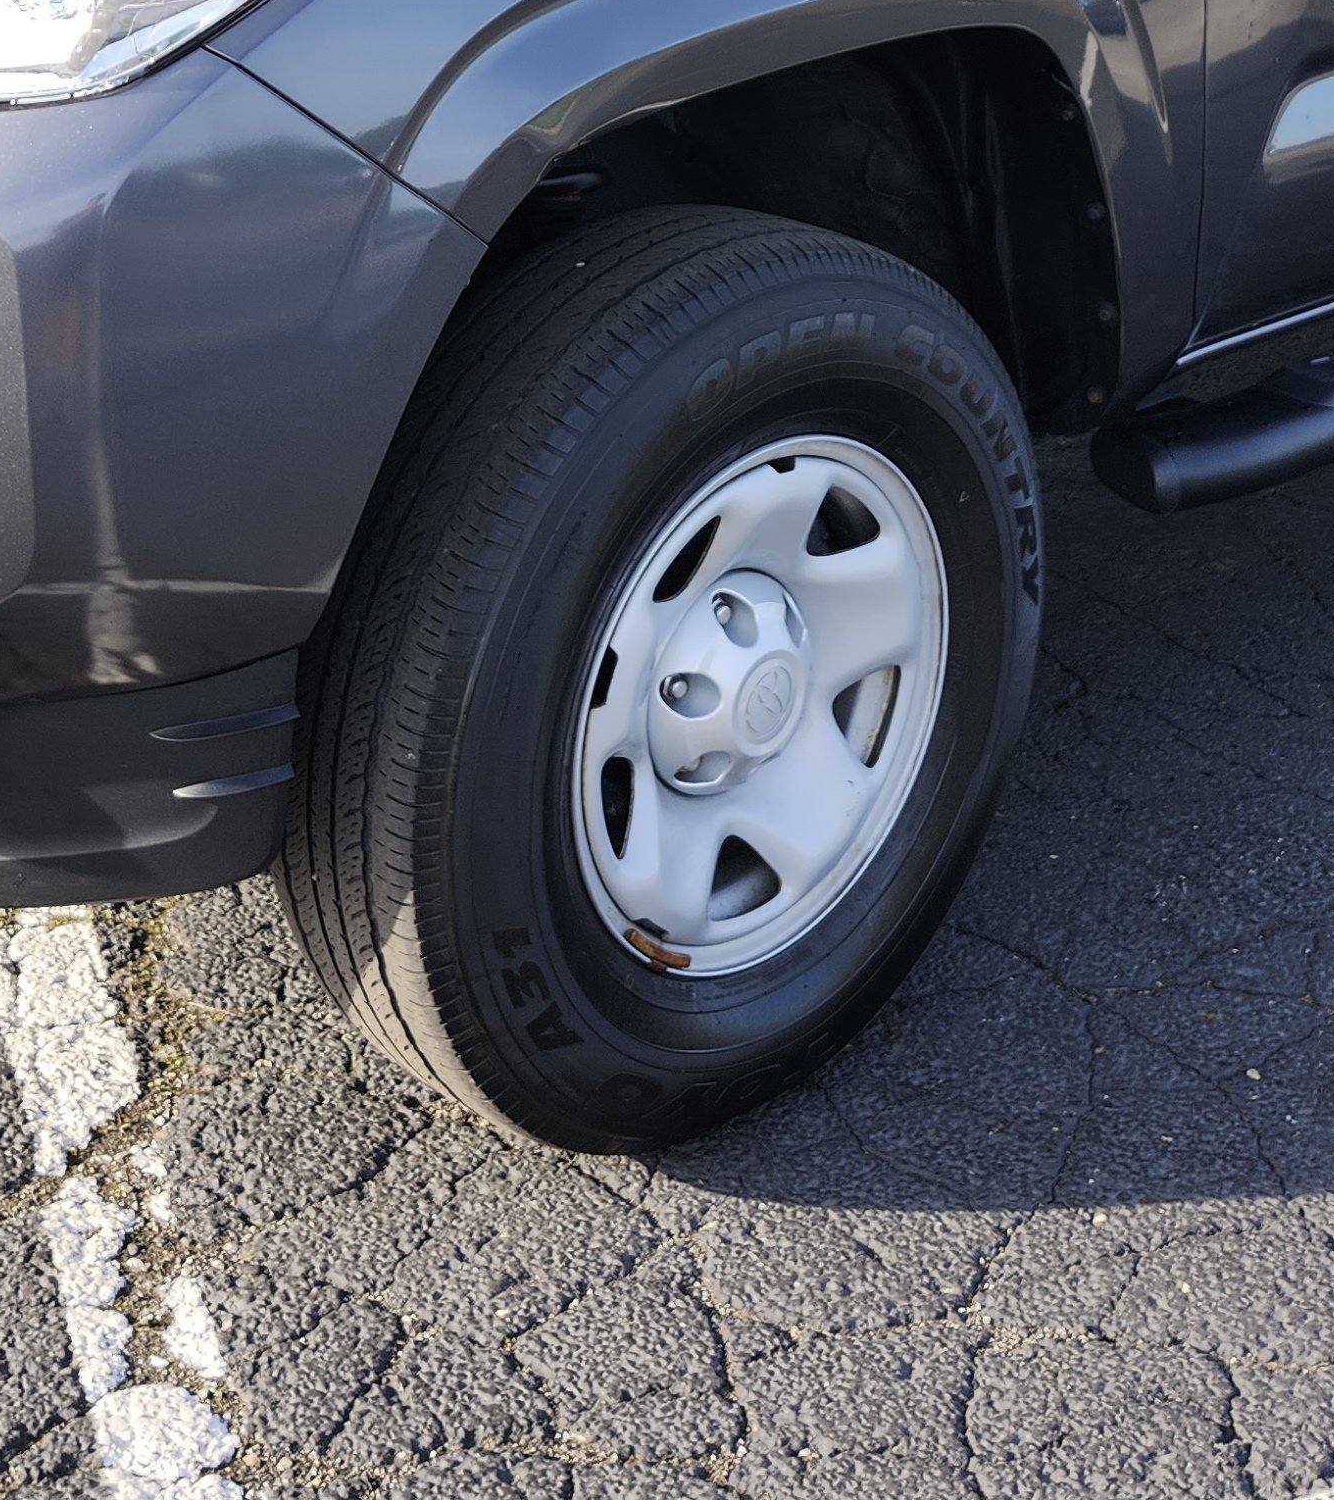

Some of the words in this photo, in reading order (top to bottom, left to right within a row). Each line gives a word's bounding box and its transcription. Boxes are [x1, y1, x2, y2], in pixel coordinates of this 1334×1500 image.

[686, 310, 878, 423] OPEN
[893, 323, 1041, 607] COUNTRY
[490, 925, 585, 1053] A31
